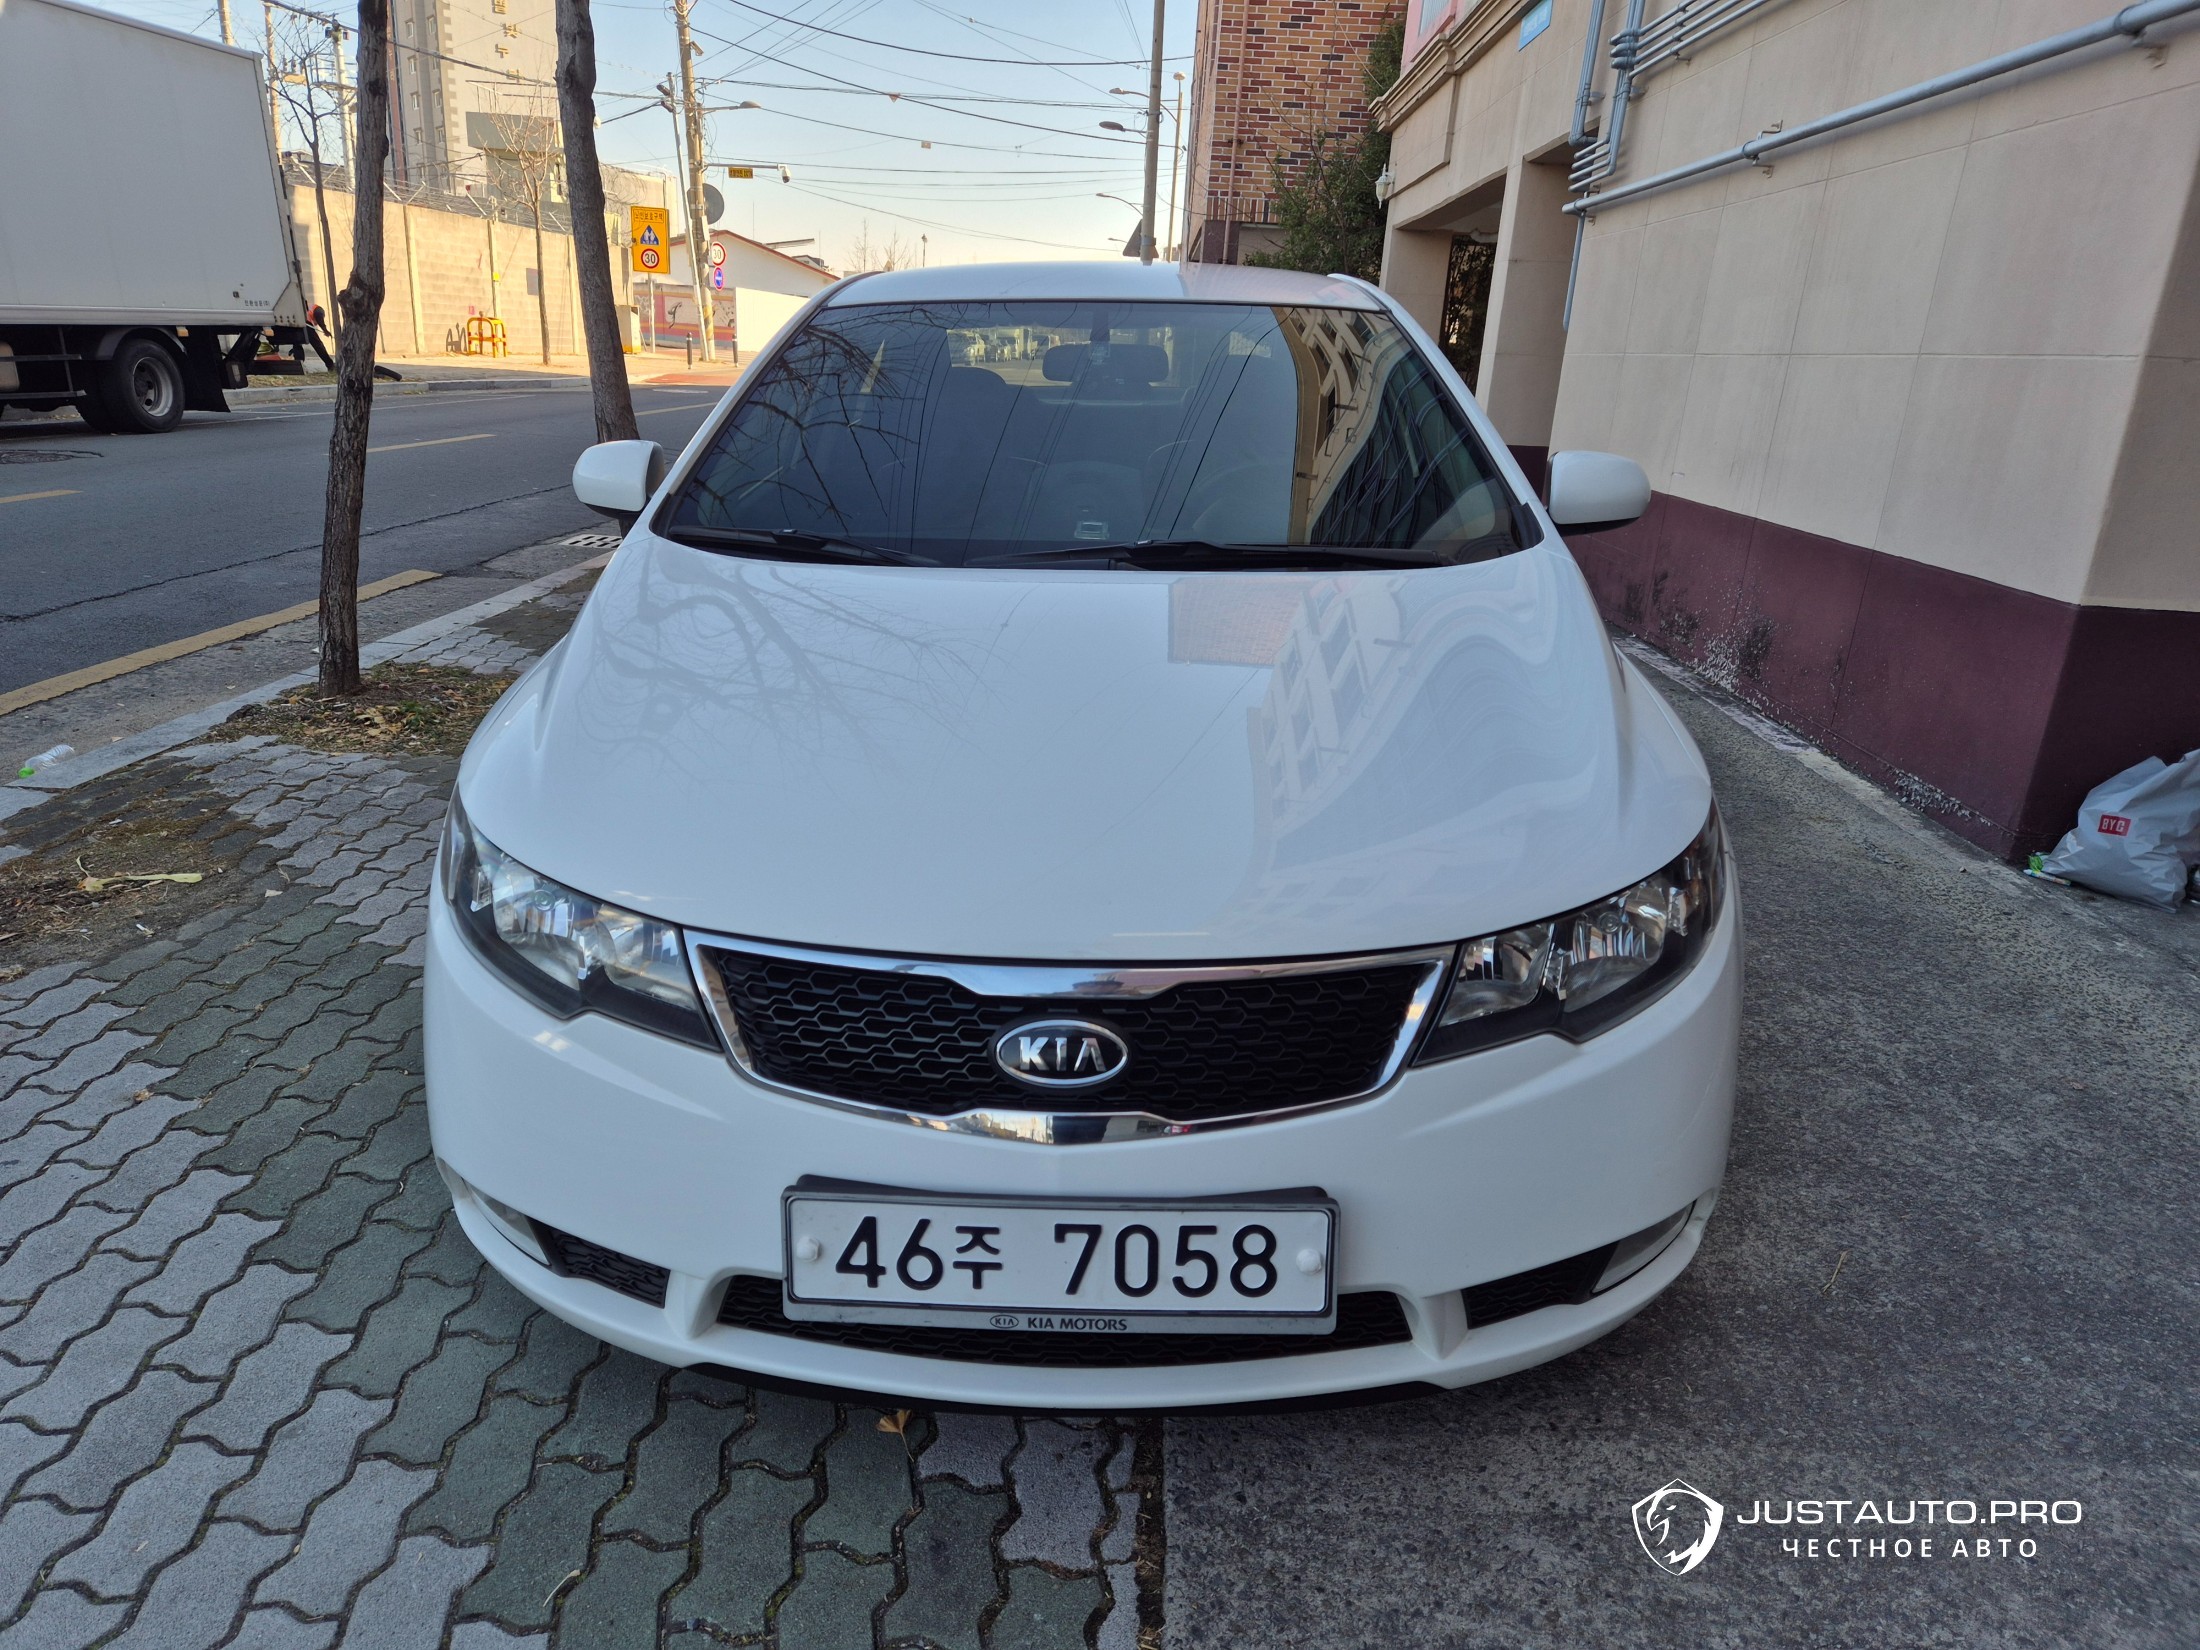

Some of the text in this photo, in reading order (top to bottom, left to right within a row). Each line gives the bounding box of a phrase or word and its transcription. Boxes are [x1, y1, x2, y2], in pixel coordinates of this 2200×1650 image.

[644, 253, 656, 264] 30
[713, 249, 722, 259] 30
[2101, 818, 2126, 832] BYC
[1019, 1037, 1106, 1071] KIA
[836, 1216, 1278, 1298] 46주 7058
[1027, 1317, 1054, 1329] KIA
[1060, 1318, 1127, 1331] MOTORS
